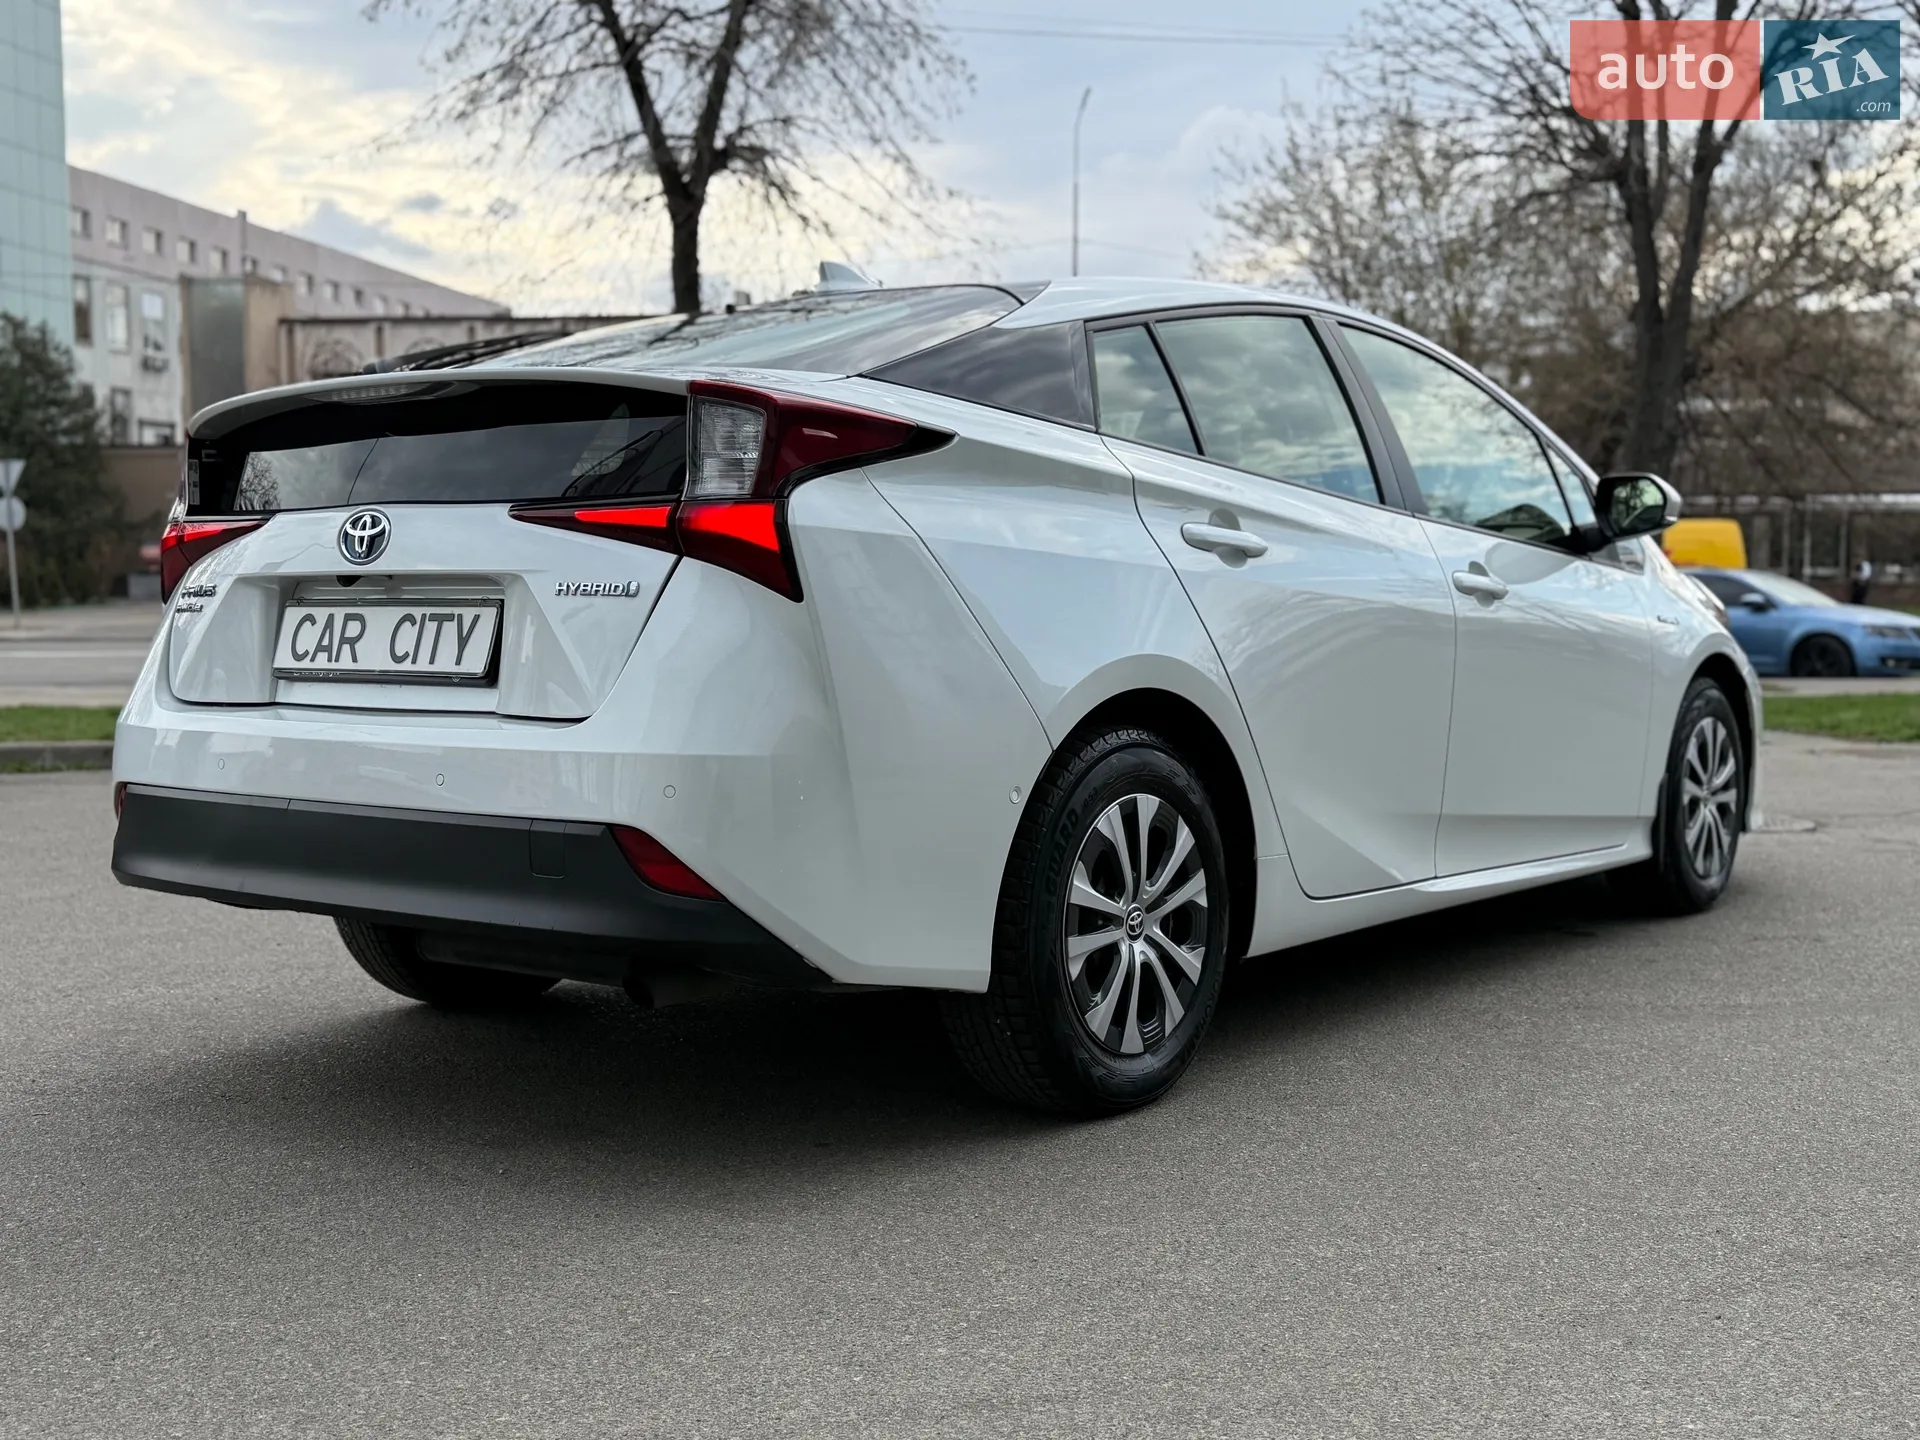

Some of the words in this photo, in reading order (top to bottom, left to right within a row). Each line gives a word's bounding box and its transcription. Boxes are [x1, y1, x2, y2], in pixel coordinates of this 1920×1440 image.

[555, 581, 626, 597] HYBRID
[290, 612, 367, 664] CAR
[389, 612, 481, 666] CITY
